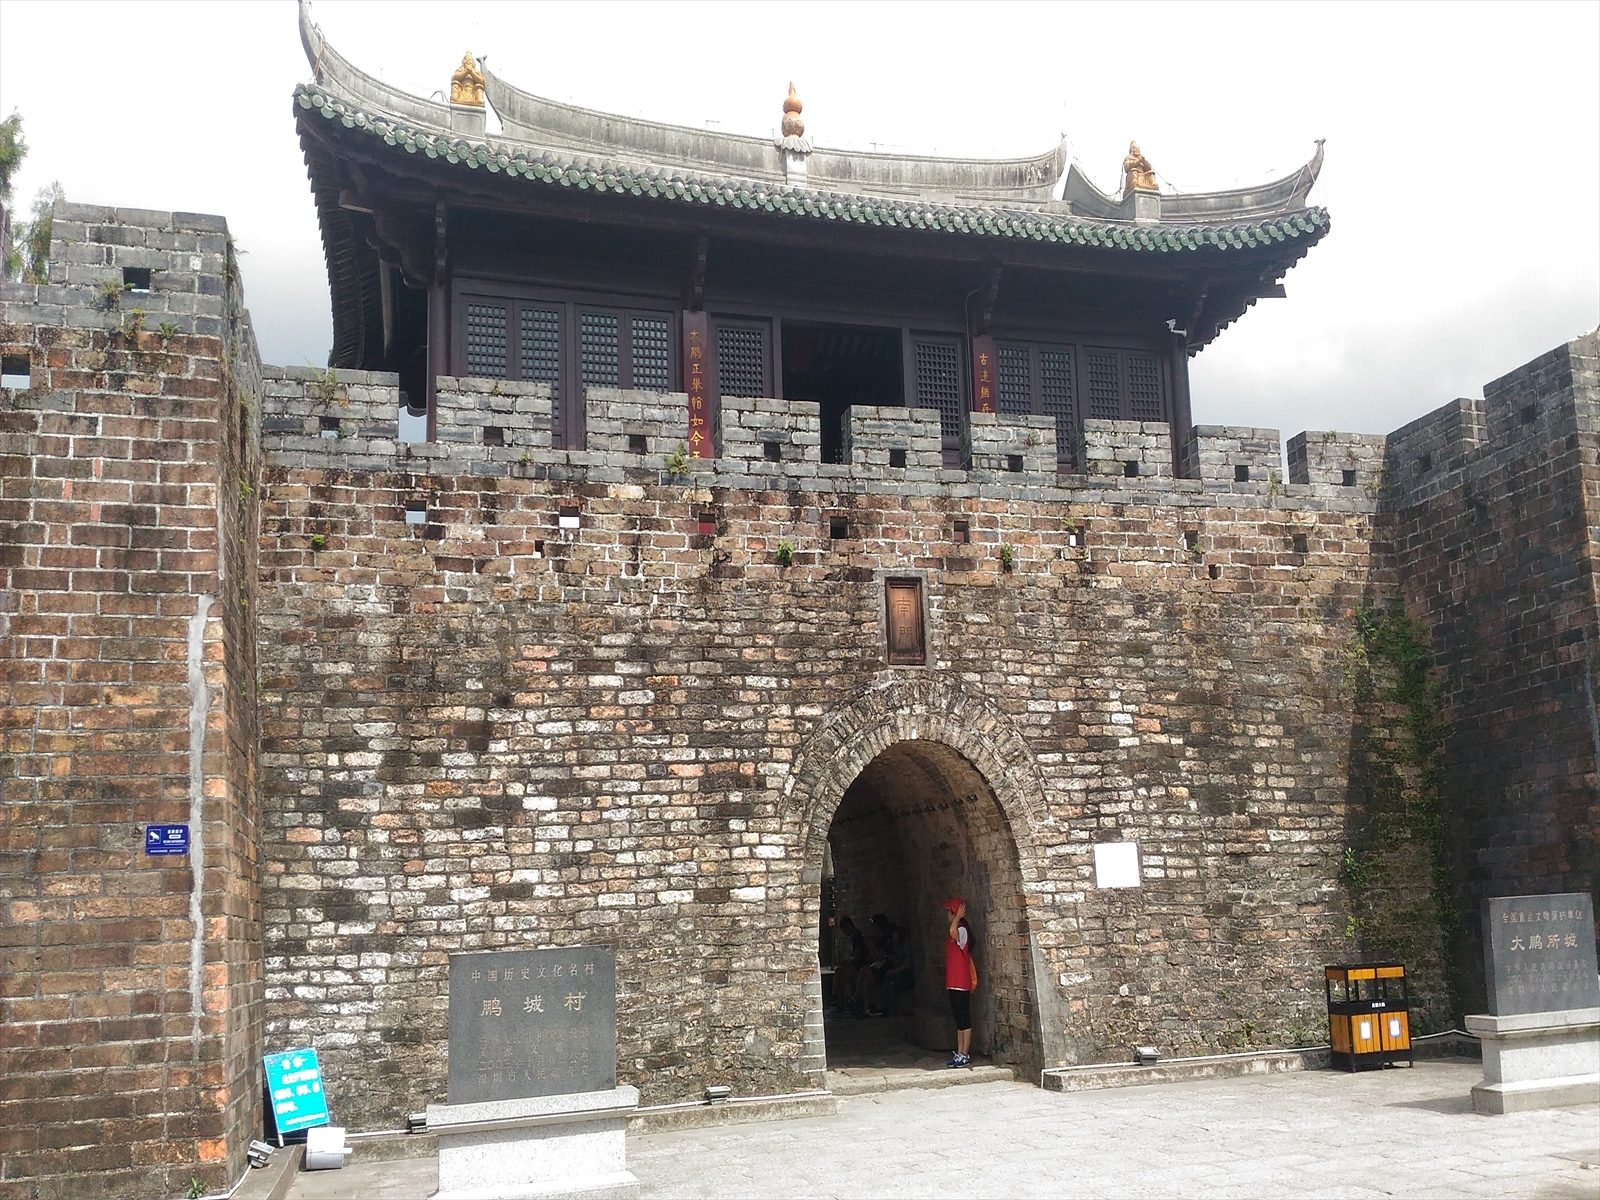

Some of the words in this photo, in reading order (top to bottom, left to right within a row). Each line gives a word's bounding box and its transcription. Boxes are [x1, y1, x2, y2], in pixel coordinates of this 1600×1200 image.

[1510, 932, 1579, 952] 大鹏所城
[471, 961, 595, 984] 中国历史文化名村
[480, 991, 586, 1017] 鹏城村
